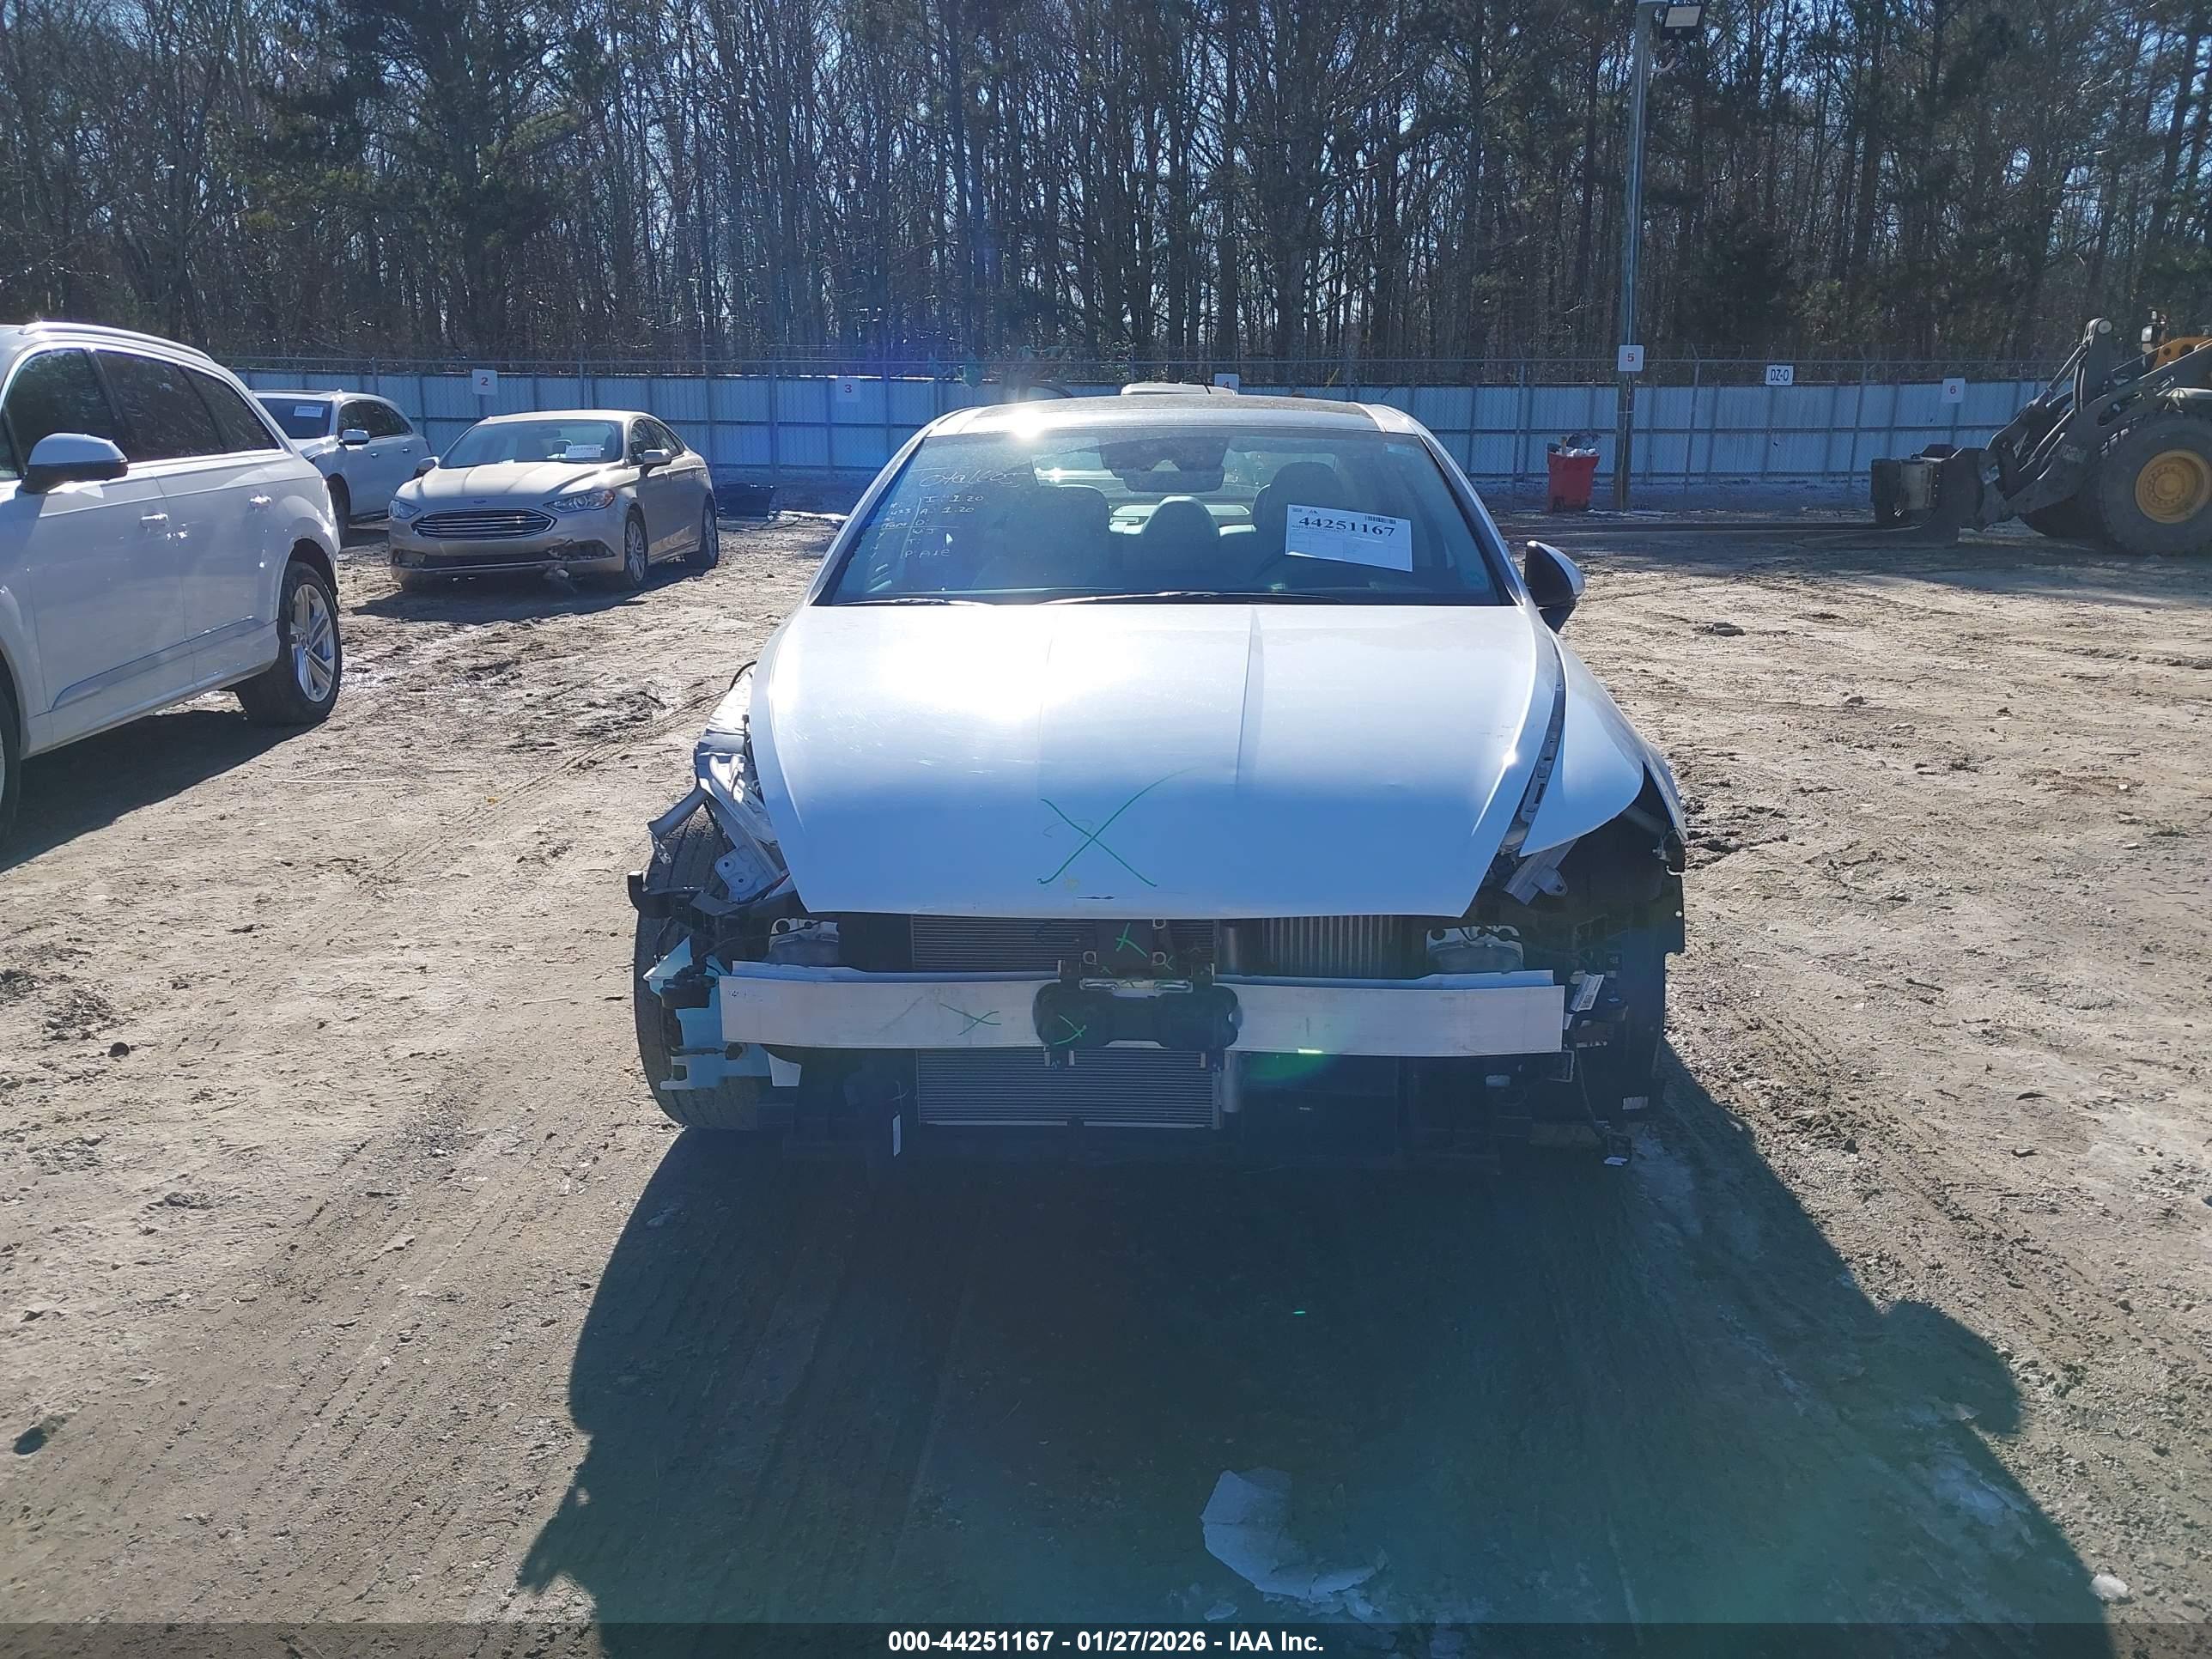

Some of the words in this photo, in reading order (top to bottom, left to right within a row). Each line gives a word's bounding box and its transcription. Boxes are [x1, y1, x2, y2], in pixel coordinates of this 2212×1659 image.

[1627, 352, 1635, 362] 5
[480, 376, 489, 386] 2
[1222, 380, 1231, 389] 4
[844, 384, 853, 393] 3
[1949, 385, 1957, 395] 6
[1298, 516, 1395, 537] 44251167
